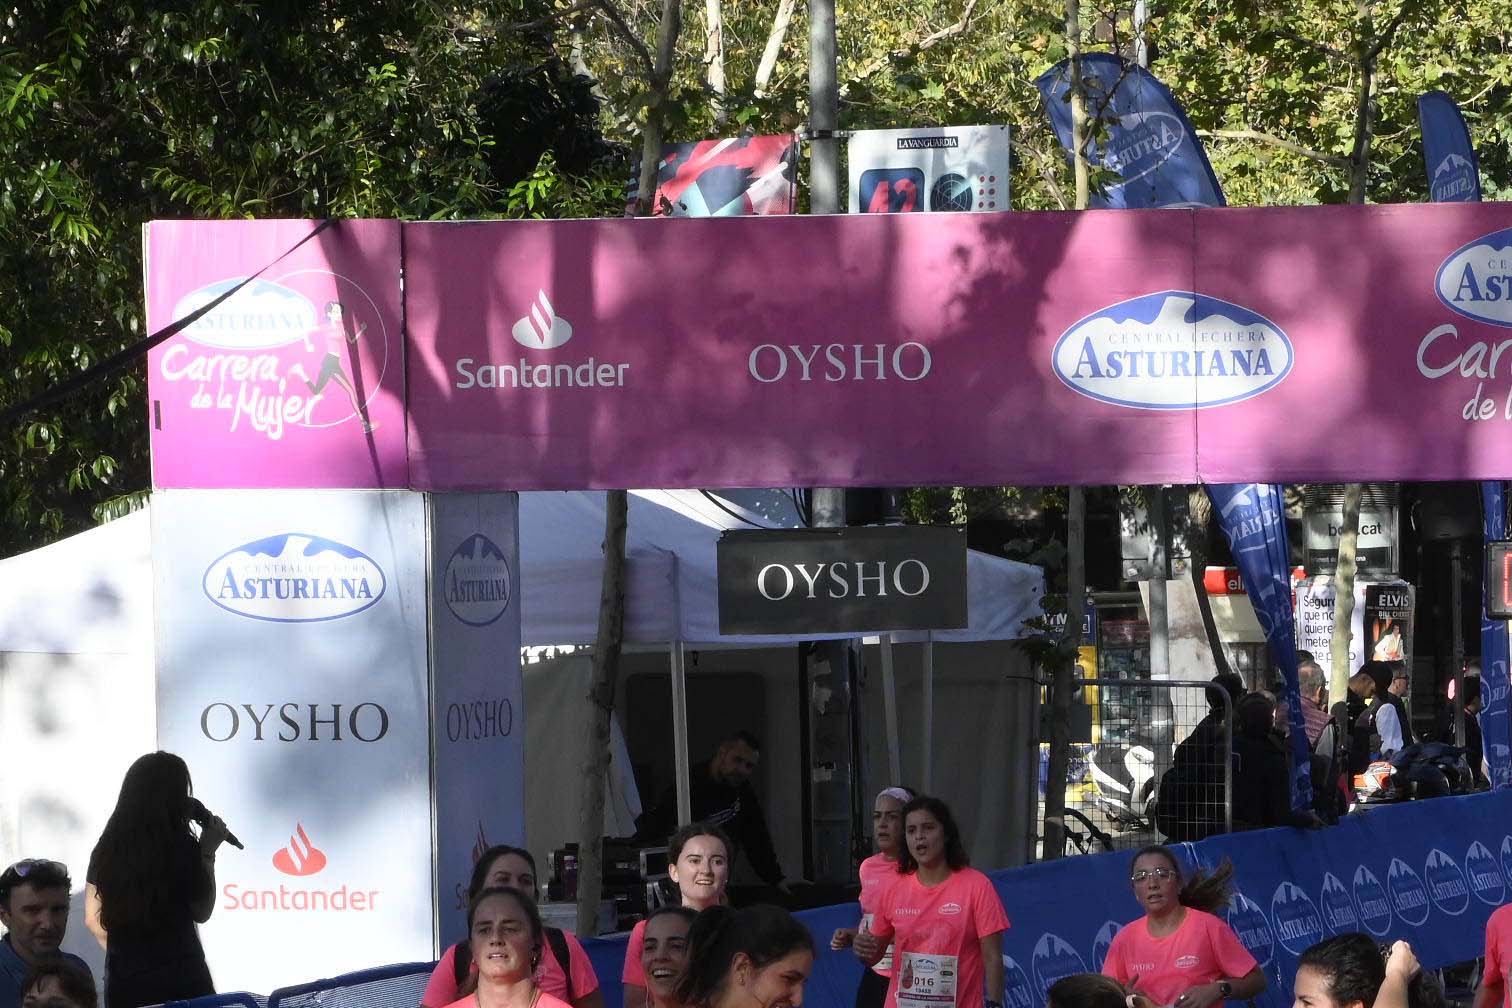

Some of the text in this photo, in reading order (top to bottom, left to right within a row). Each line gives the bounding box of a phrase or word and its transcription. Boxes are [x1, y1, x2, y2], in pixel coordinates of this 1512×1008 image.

[1109, 330, 1267, 345] CENTRAL LECHERA
[160, 343, 279, 382] Carrera
[456, 358, 629, 389] Santander
[748, 342, 932, 383] OYSHO
[1072, 336, 1275, 379] ASTURIANA
[190, 378, 323, 440] de la Mujer
[1462, 382, 1497, 421] de
[217, 567, 375, 600] ASTURIANA
[449, 567, 507, 603] ASTURIANA
[756, 558, 931, 601] OYSHO
[1378, 594, 1409, 607] ELVIS
[200, 702, 390, 743] OYSHO
[446, 698, 513, 743] OYSHO
[223, 883, 379, 912] Santander
[914, 977, 935, 987] 016
